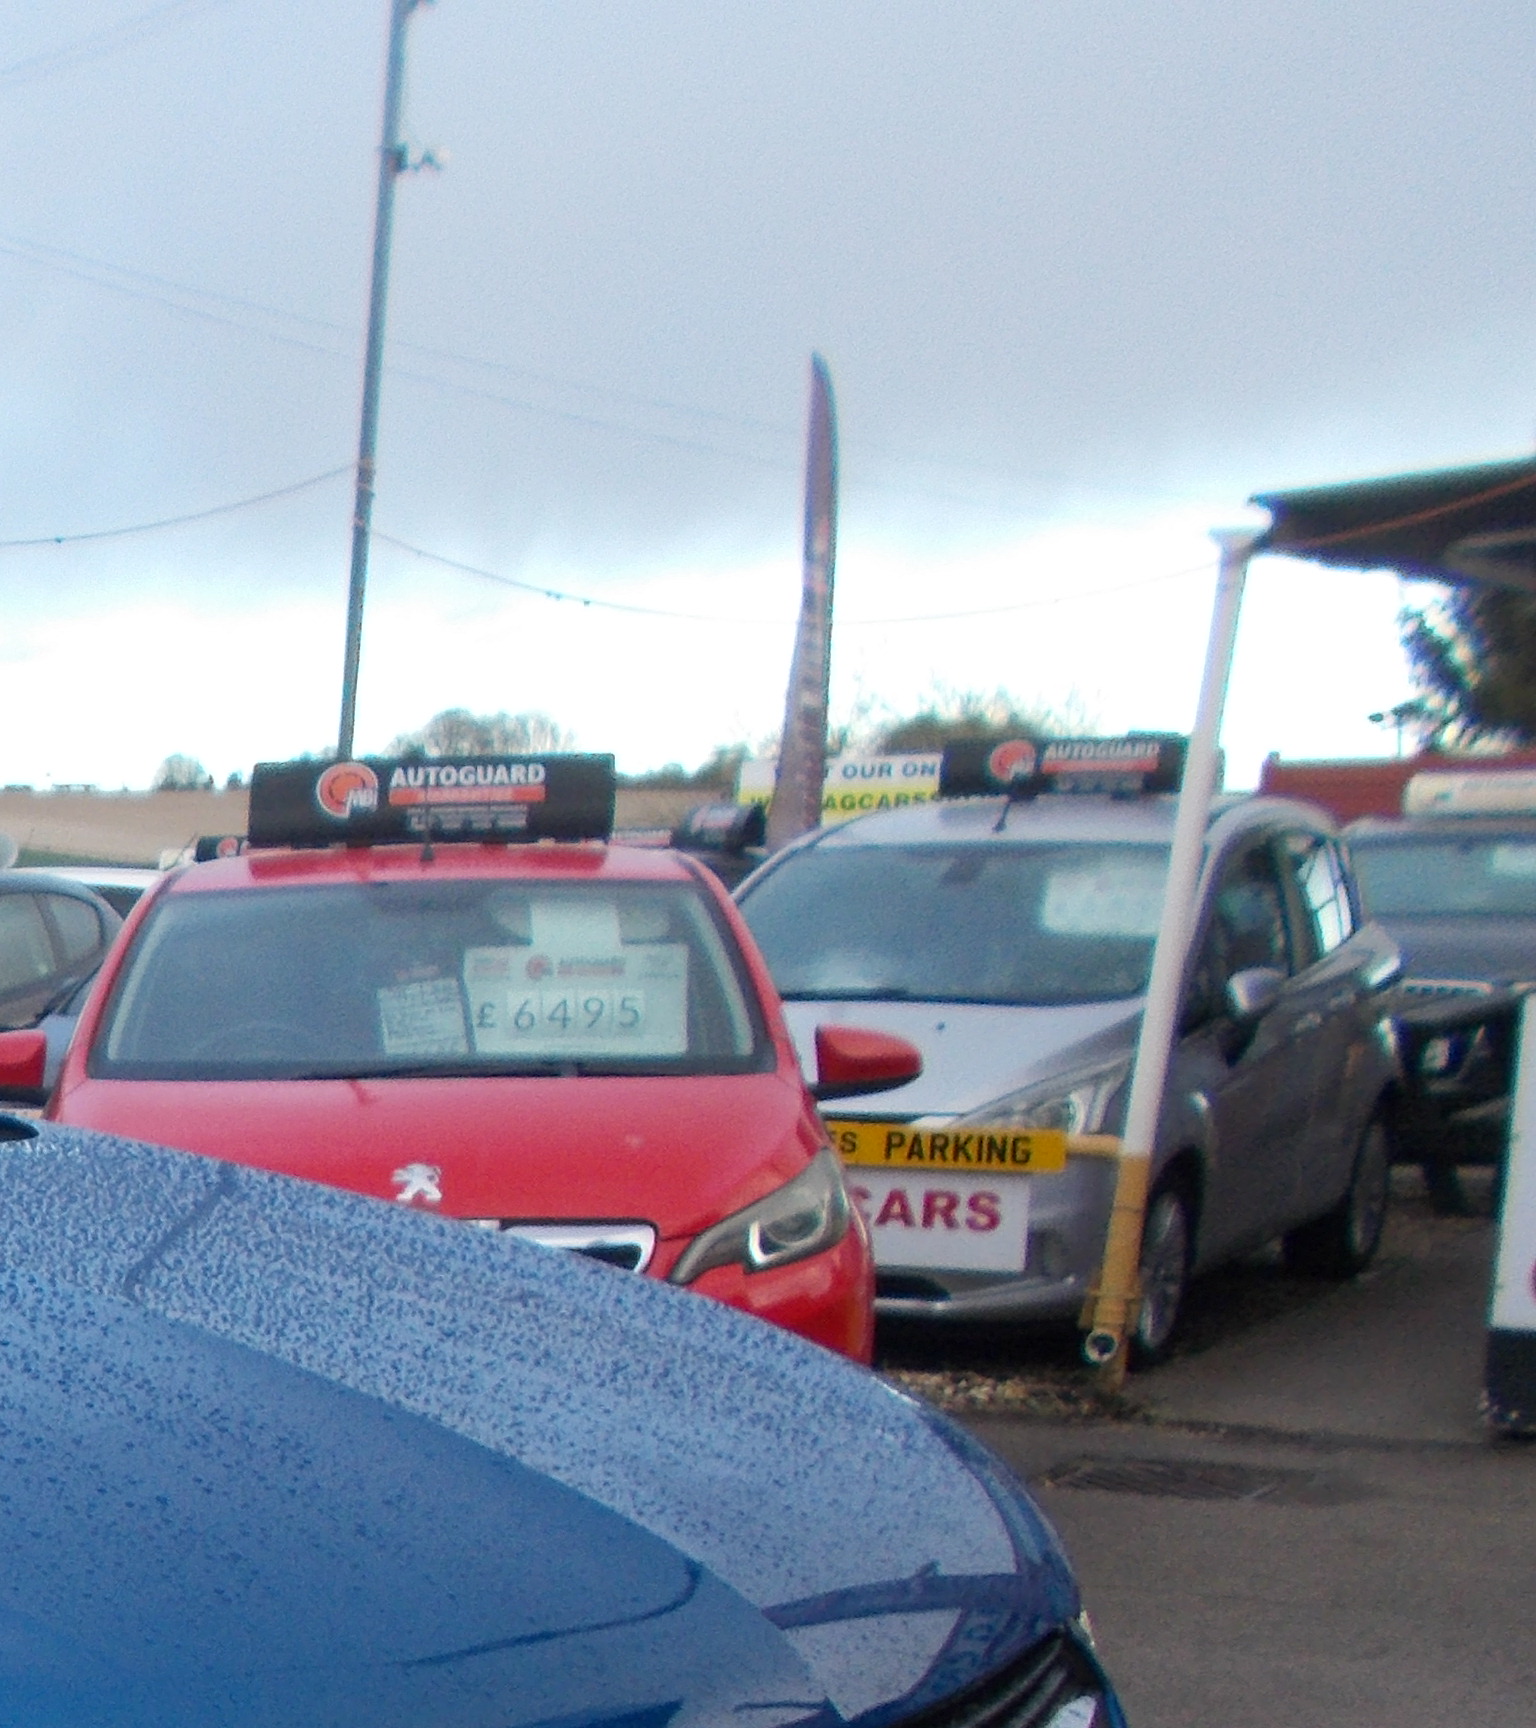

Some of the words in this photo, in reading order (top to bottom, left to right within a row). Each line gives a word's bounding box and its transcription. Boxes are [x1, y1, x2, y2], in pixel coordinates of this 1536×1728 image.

[391, 763, 546, 788] AUTOGUARD
[842, 762, 892, 780] OUR
[477, 997, 641, 1032] £6495
[885, 1131, 1033, 1164] PARKING
